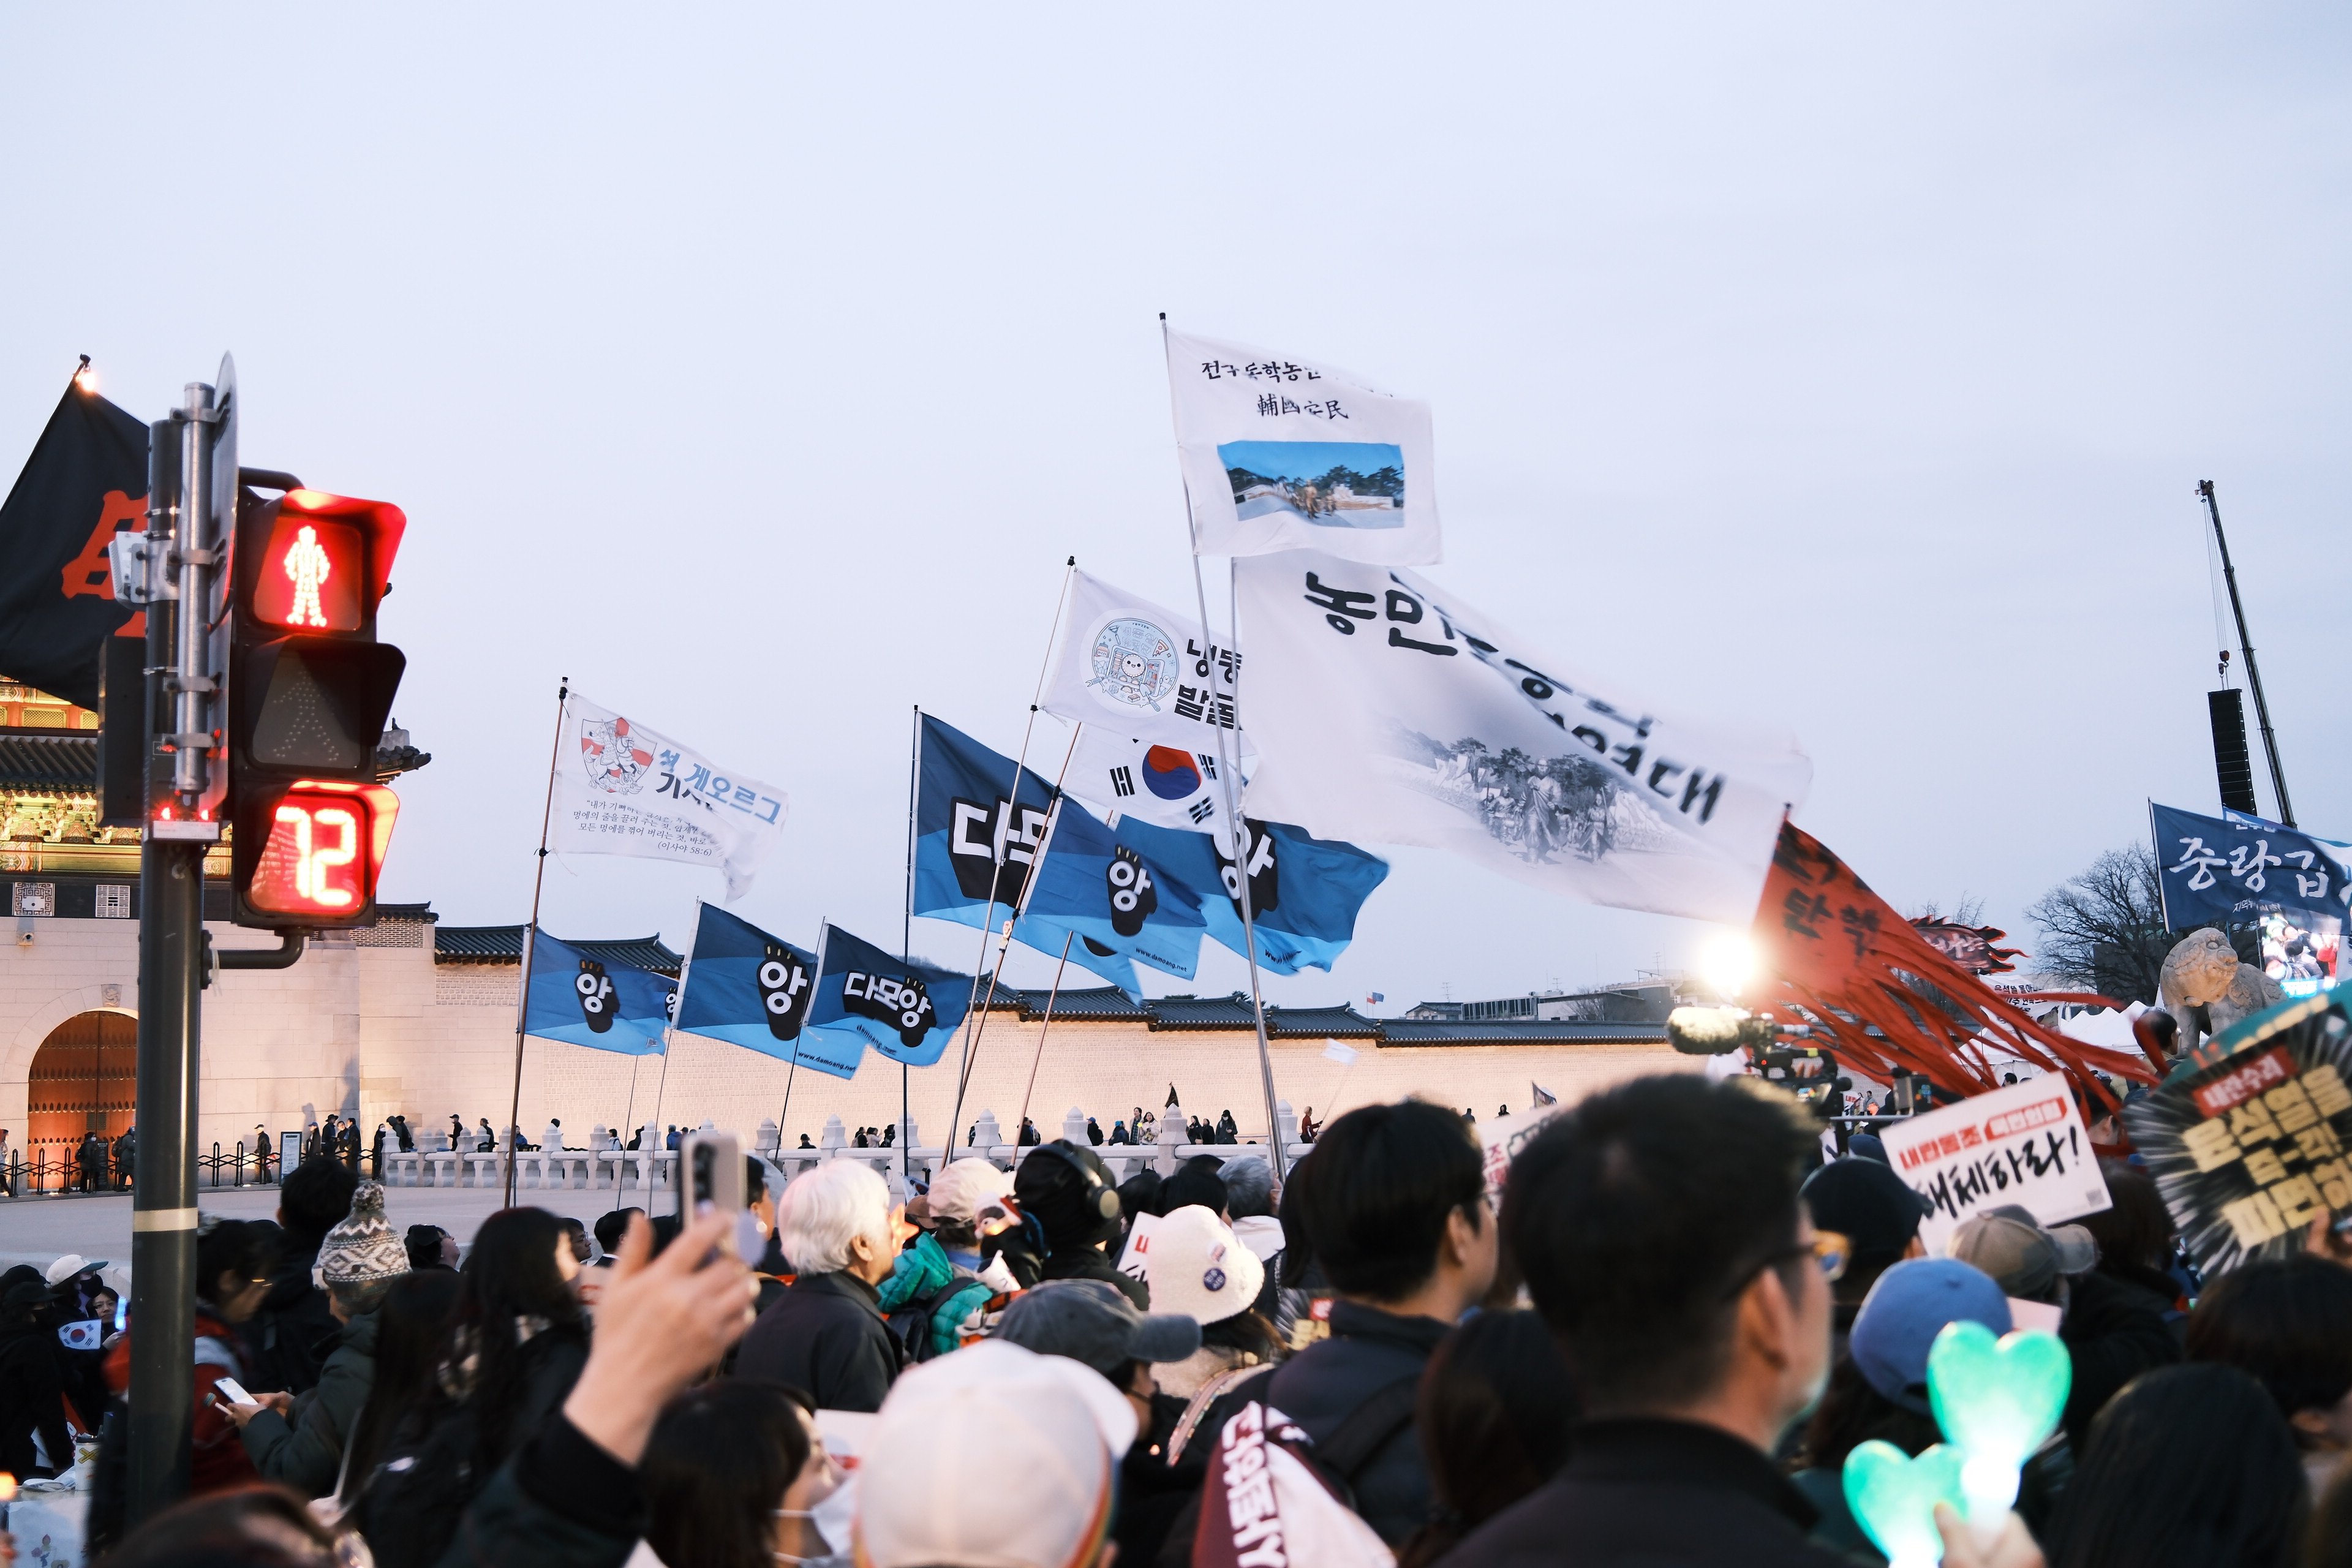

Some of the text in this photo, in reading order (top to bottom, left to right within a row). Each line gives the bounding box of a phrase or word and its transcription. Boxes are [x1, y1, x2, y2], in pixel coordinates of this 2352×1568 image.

[684, 762, 782, 826] 게오르그
[573, 810, 599, 821] 멍에의
[620, 813, 639, 824] 끌러
[578, 823, 597, 832] 모든
[600, 824, 626, 834] 멍에를
[647, 828, 674, 840] 버리는
[690, 836, 707, 845] 바로
[274, 803, 357, 907] 72
[657, 842, 712, 857] (이사야 58:6)
[1108, 859, 1152, 913] 앙
[1135, 946, 1188, 973] www.damoang.net
[576, 971, 614, 1014] 앙
[760, 960, 809, 1016] 앙
[843, 971, 932, 1030] 다모앙
[797, 1051, 858, 1072] www.damoang.net
